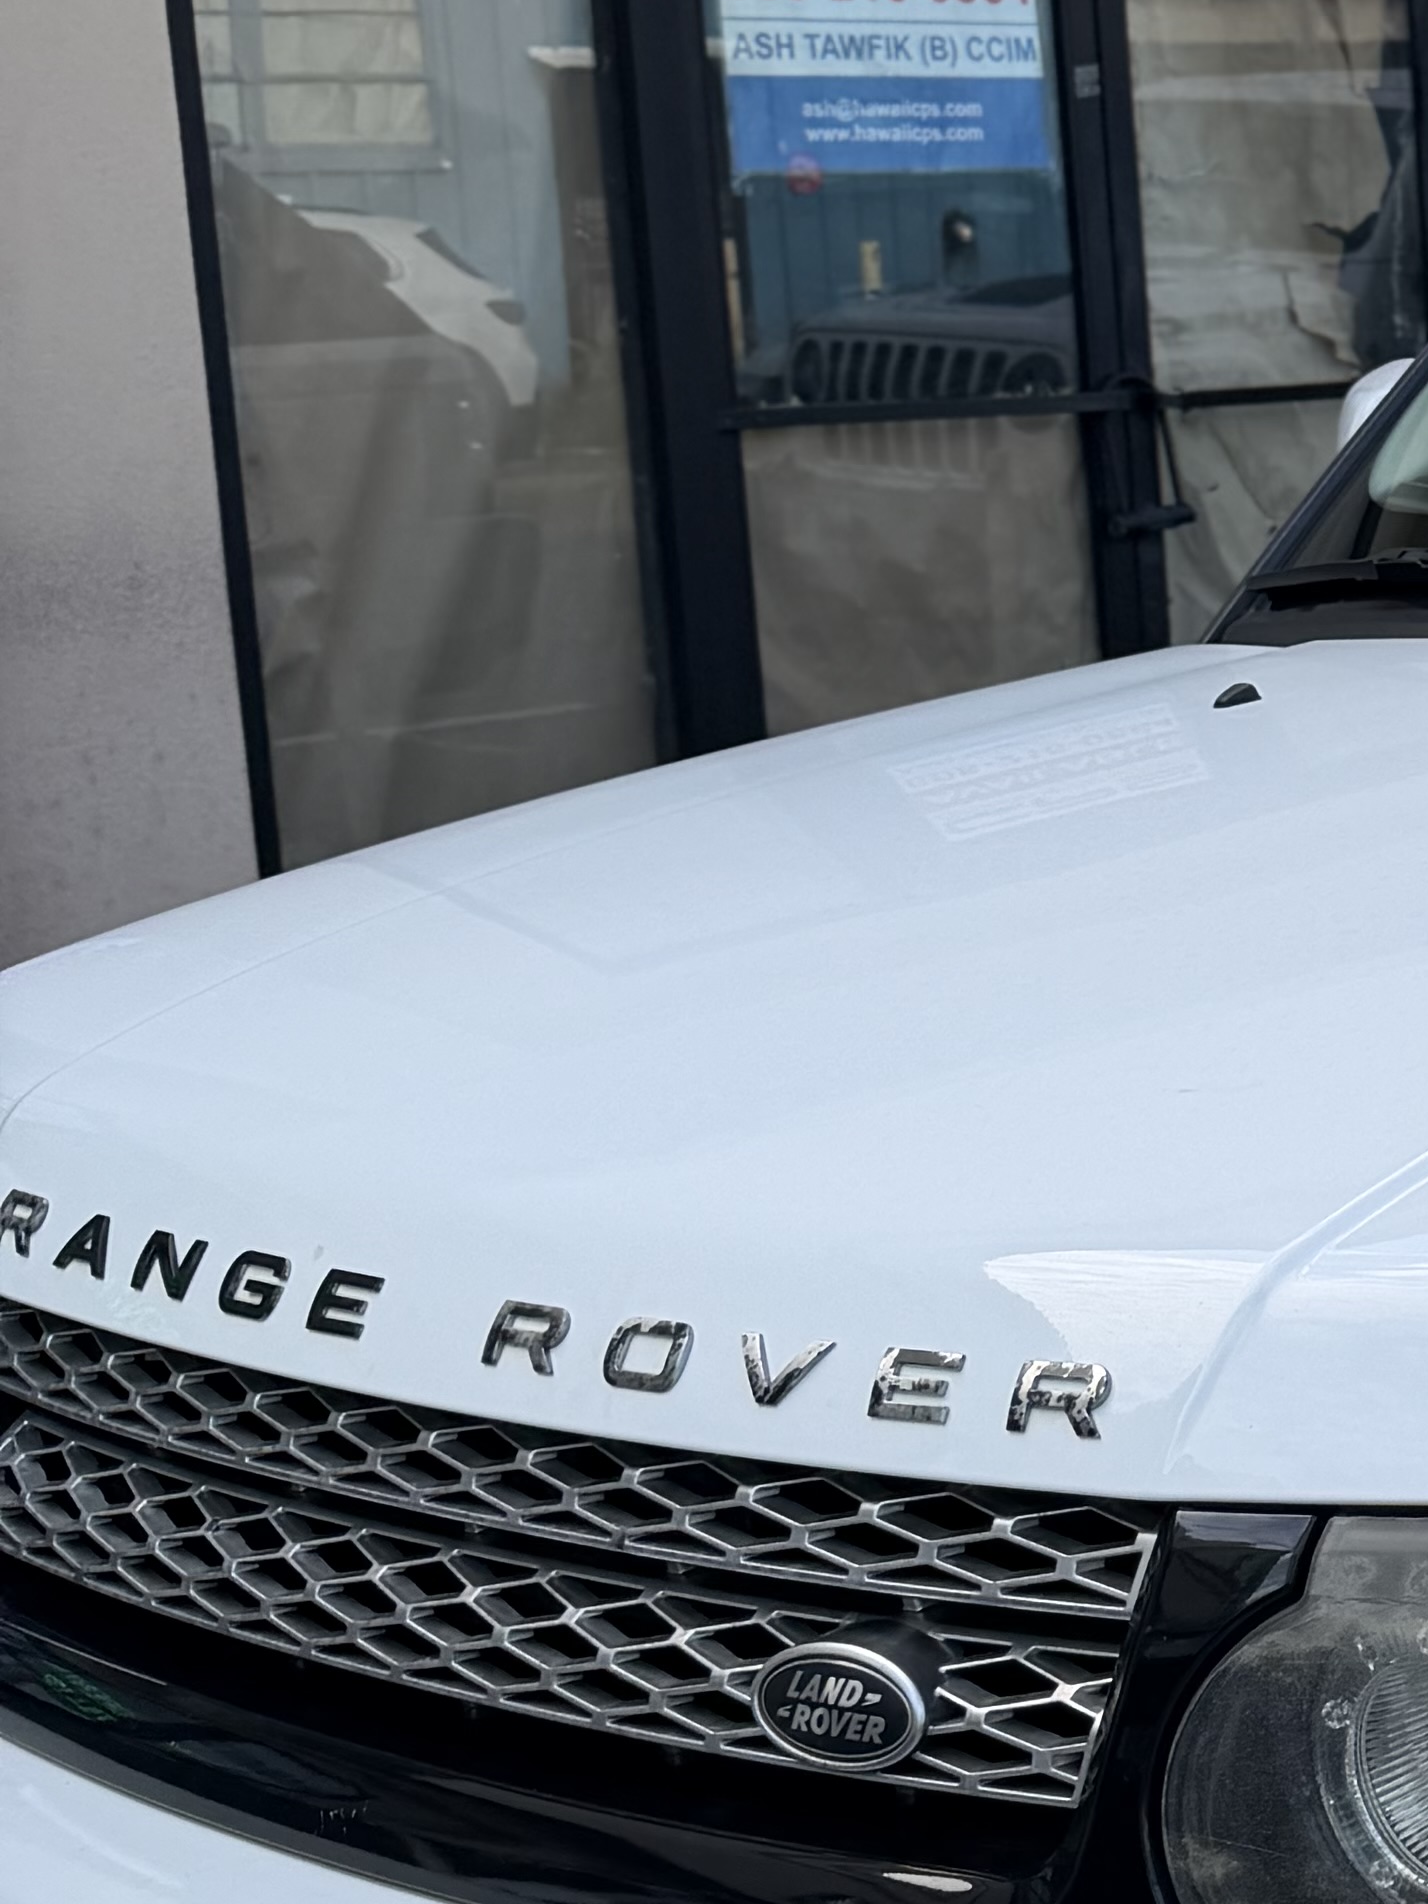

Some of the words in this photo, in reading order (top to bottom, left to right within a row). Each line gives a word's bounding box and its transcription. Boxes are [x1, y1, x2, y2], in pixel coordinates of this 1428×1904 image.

[732, 32, 796, 61] ASH
[804, 33, 913, 63] TAWFIK
[920, 35, 959, 68] (B)
[965, 36, 1038, 64] CCIM
[801, 98, 984, 122] ash@hawaiicps.com
[804, 124, 985, 145] www.hawaiicps.com
[0, 1188, 386, 1341] RANGE
[480, 1298, 1113, 1440] ROVER
[786, 1670, 864, 1708] LAND
[790, 1702, 886, 1745] ROVER
